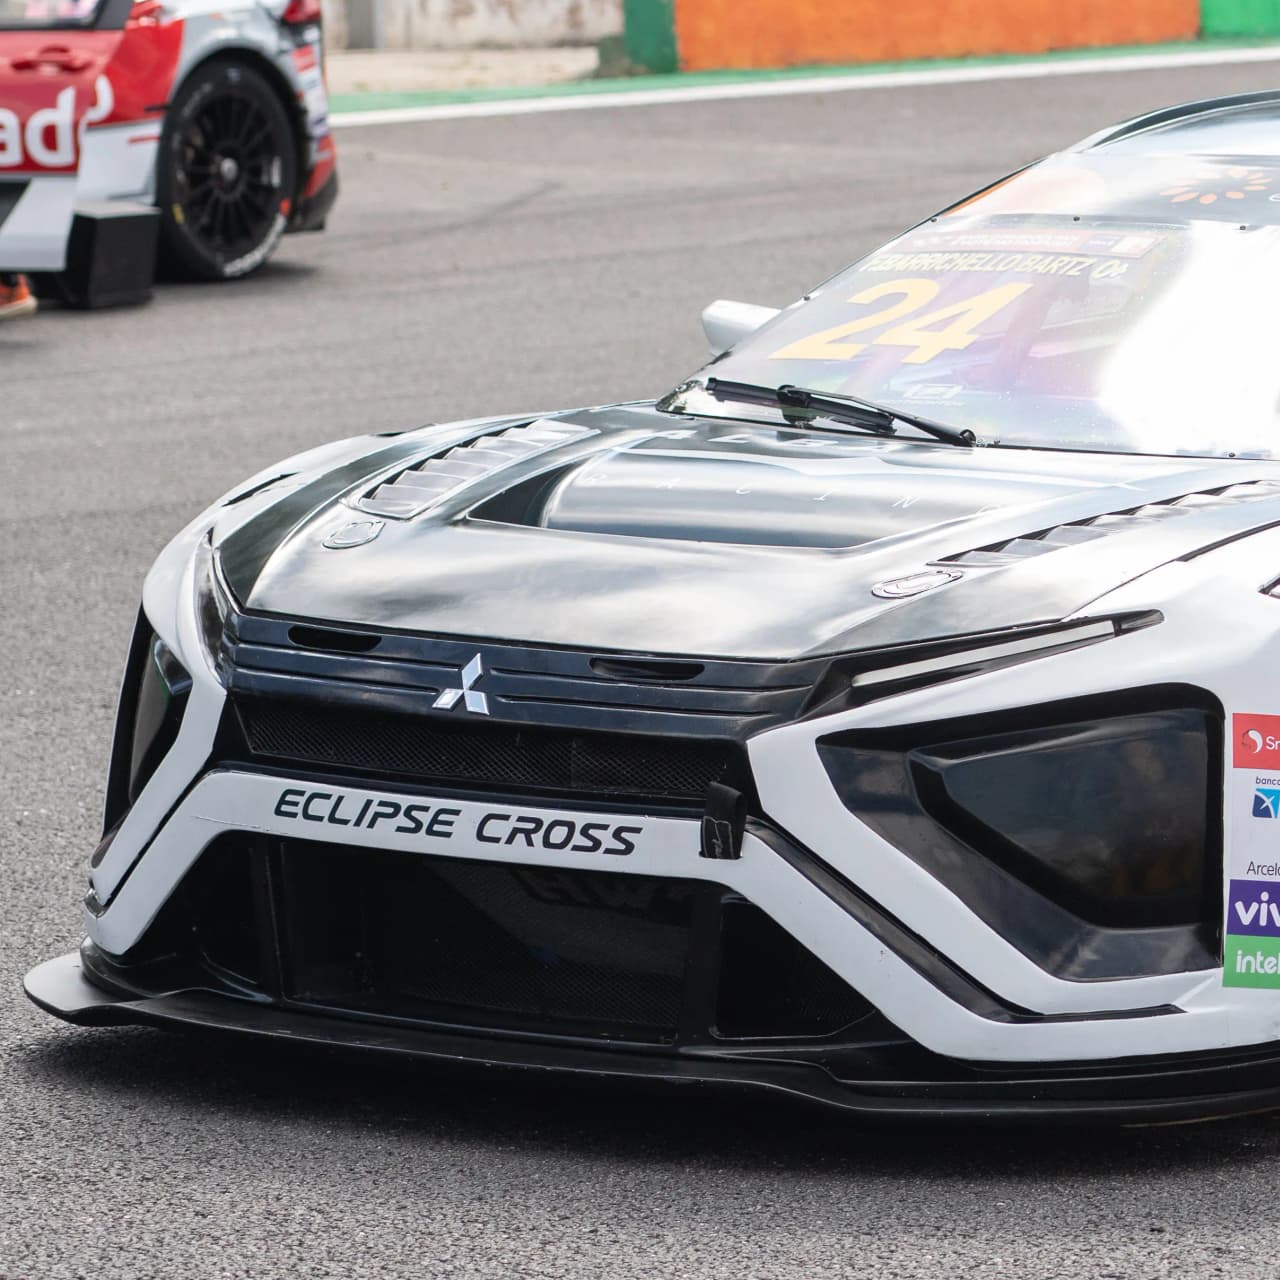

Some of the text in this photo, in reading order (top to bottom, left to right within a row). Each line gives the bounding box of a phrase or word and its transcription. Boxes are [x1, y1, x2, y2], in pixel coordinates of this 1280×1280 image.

[770, 278, 1034, 365] 24
[274, 788, 643, 856] ECLIPSE CROSS
